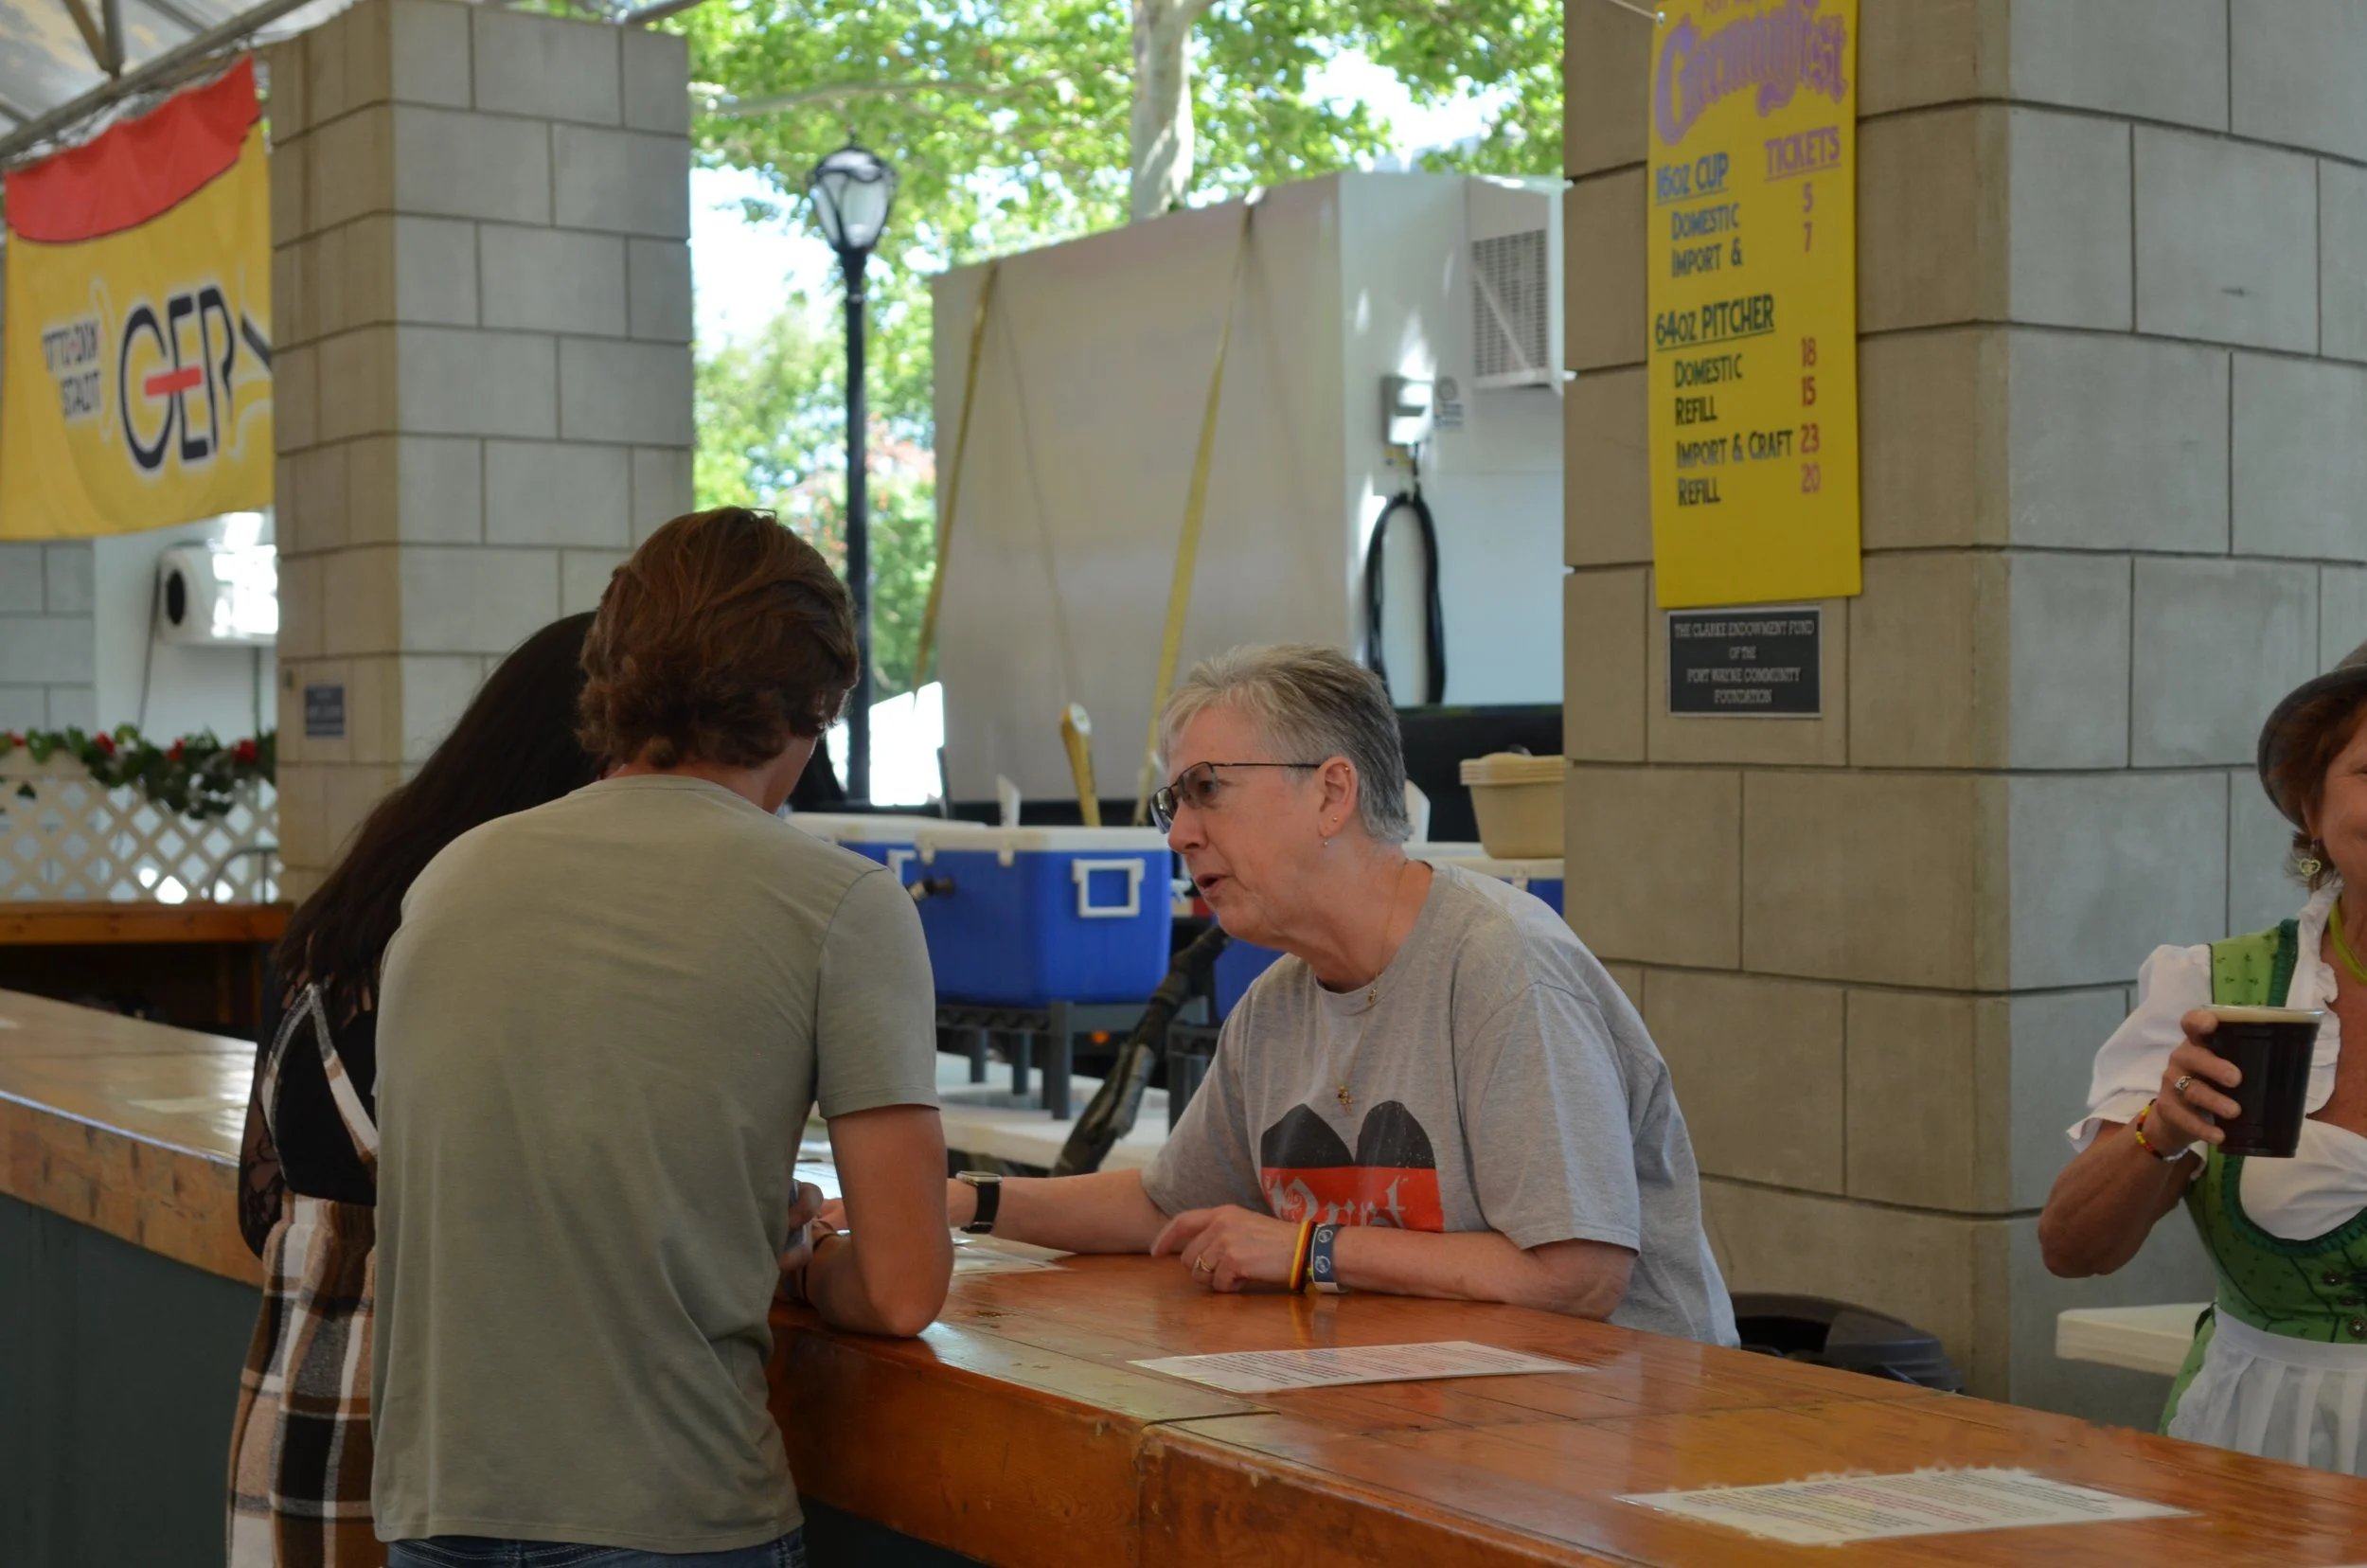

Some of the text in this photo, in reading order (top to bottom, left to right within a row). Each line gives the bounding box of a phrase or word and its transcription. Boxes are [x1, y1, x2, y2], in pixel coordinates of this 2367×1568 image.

[1695, 151, 1729, 192] CUP
[1764, 125, 1842, 176] TICKETS
[1671, 182, 1814, 241] DOMESTIC 5
[1671, 220, 1813, 278] IMPORT & 7
[1701, 294, 1774, 339] PITCHER
[1674, 336, 1817, 388] DOMESTIC 18
[1675, 375, 1817, 426] REFILL 15
[1676, 422, 1820, 470] IMPORT & CRAFT 23
[1678, 463, 1821, 507] REFILL 20
[1674, 622, 1691, 638] THE
[1788, 619, 1816, 635] FUND
[1729, 646, 1740, 660] OF
[1714, 688, 1773, 704] FOUNDATION
